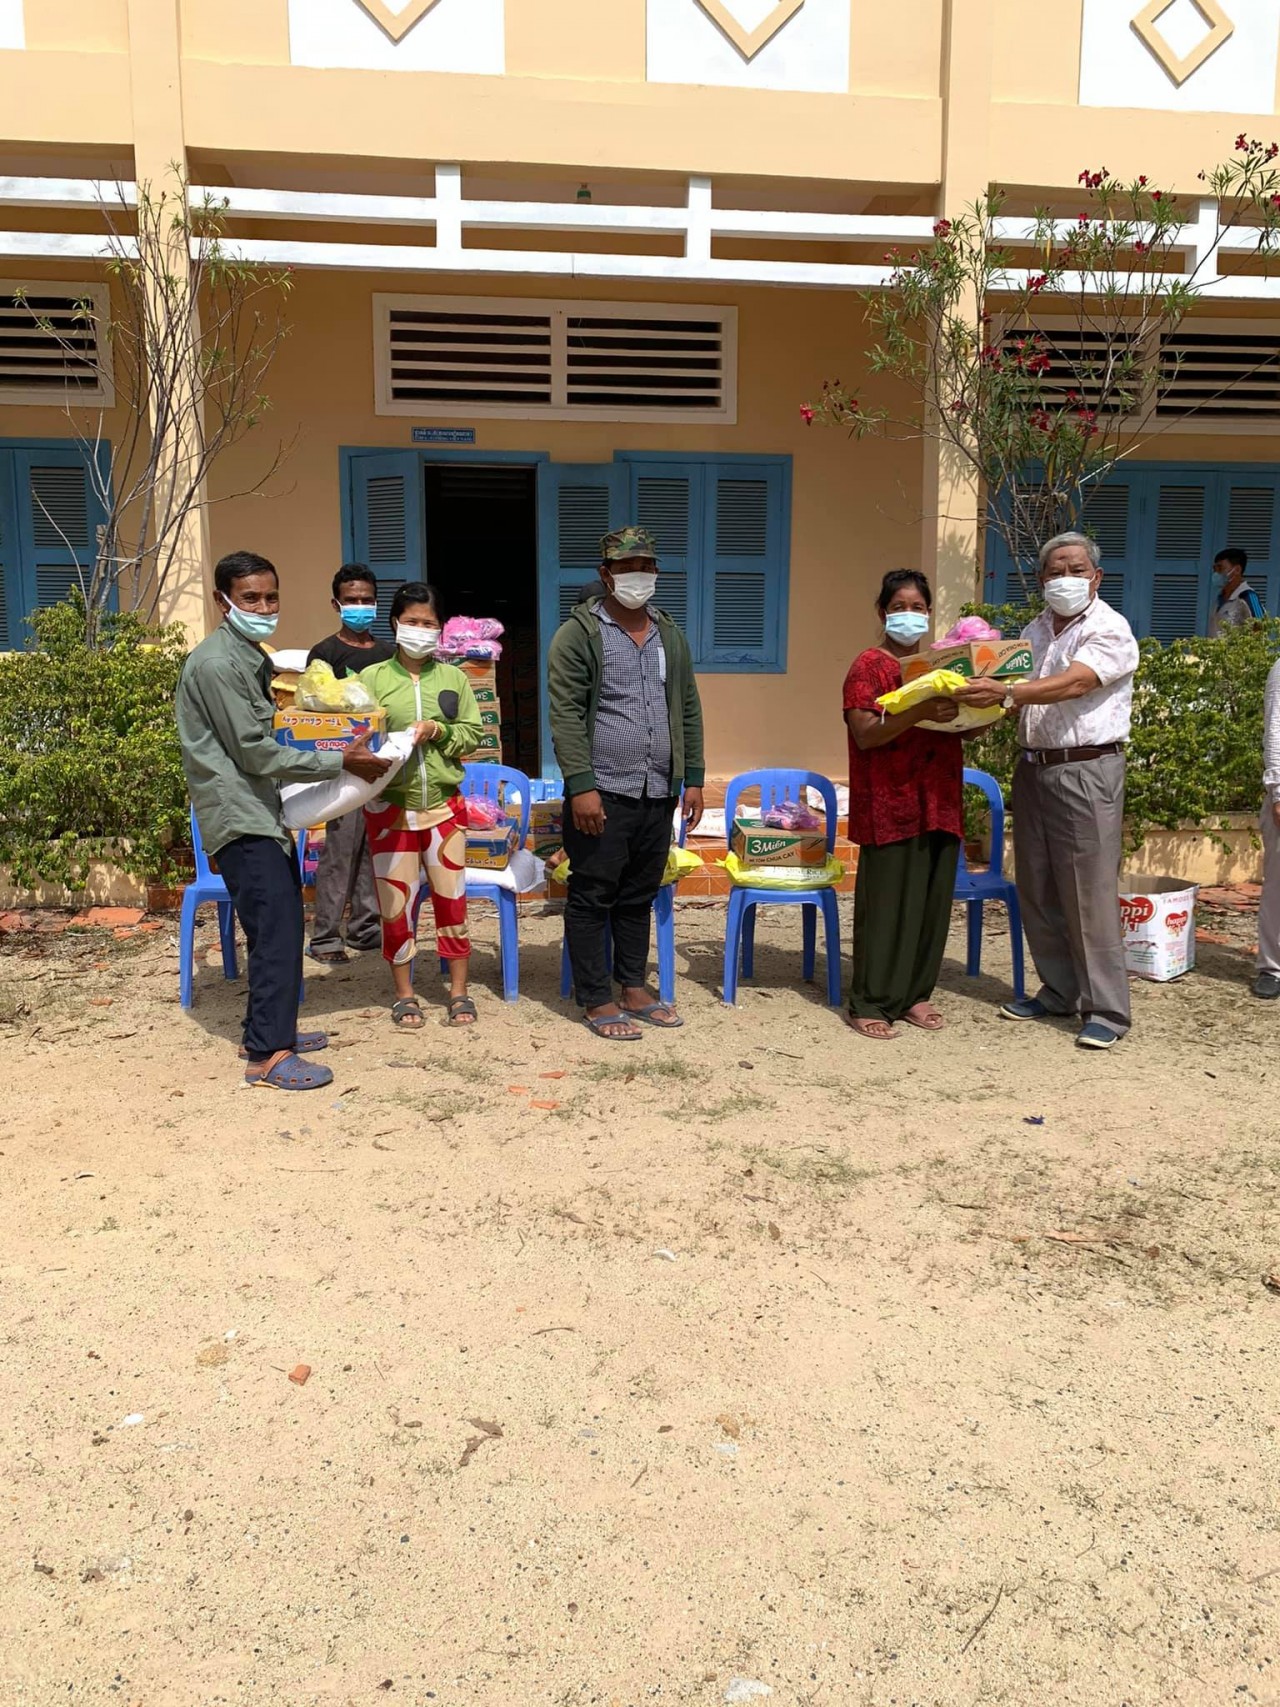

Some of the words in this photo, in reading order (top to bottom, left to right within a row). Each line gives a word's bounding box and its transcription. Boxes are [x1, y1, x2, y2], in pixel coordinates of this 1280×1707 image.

[782, 851, 795, 860] CAY
[1120, 903, 1149, 919] ppi
[1121, 917, 1139, 932] ki
